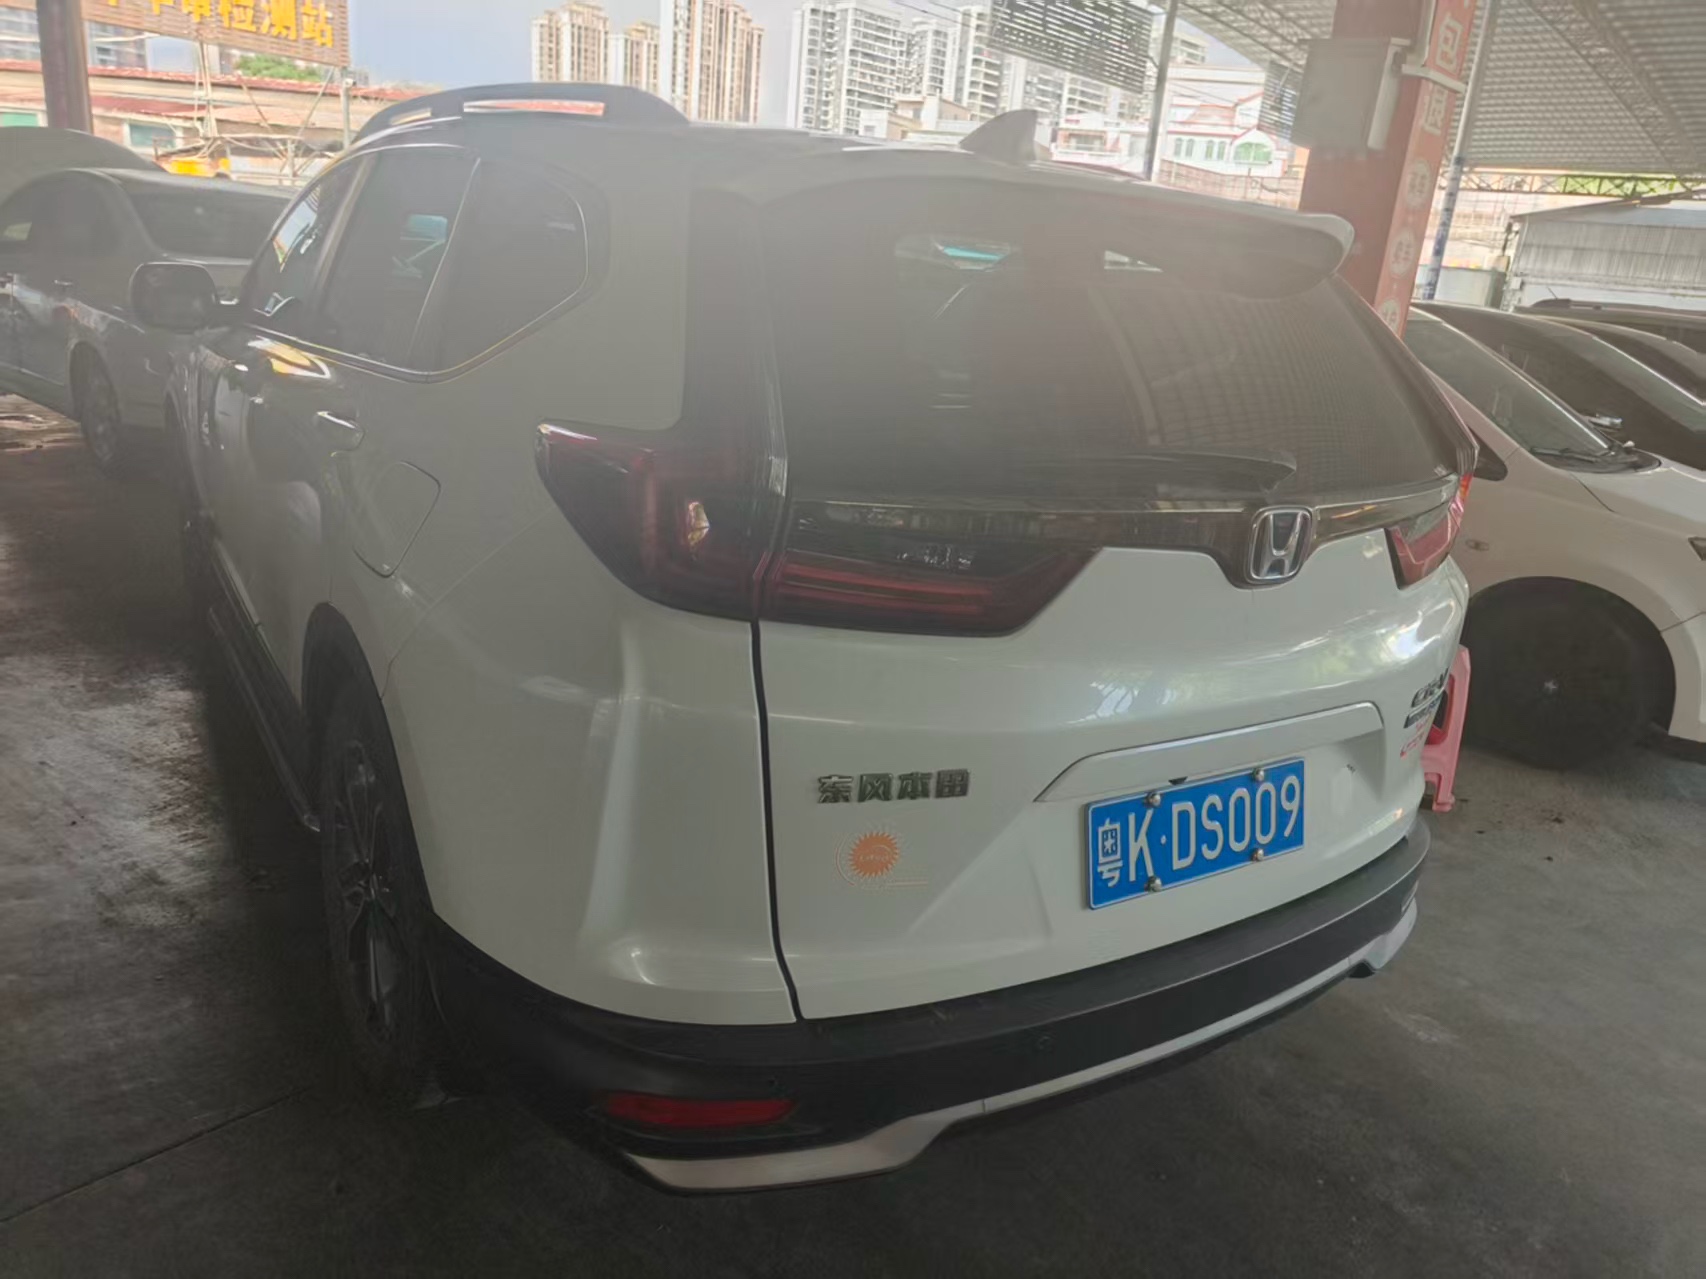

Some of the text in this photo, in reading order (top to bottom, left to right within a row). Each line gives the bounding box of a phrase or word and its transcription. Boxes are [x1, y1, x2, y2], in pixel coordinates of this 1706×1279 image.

[152, 0, 334, 48] 检测站
[817, 768, 971, 804] 东风本田
[1097, 774, 1301, 888] 粤K·DS009
